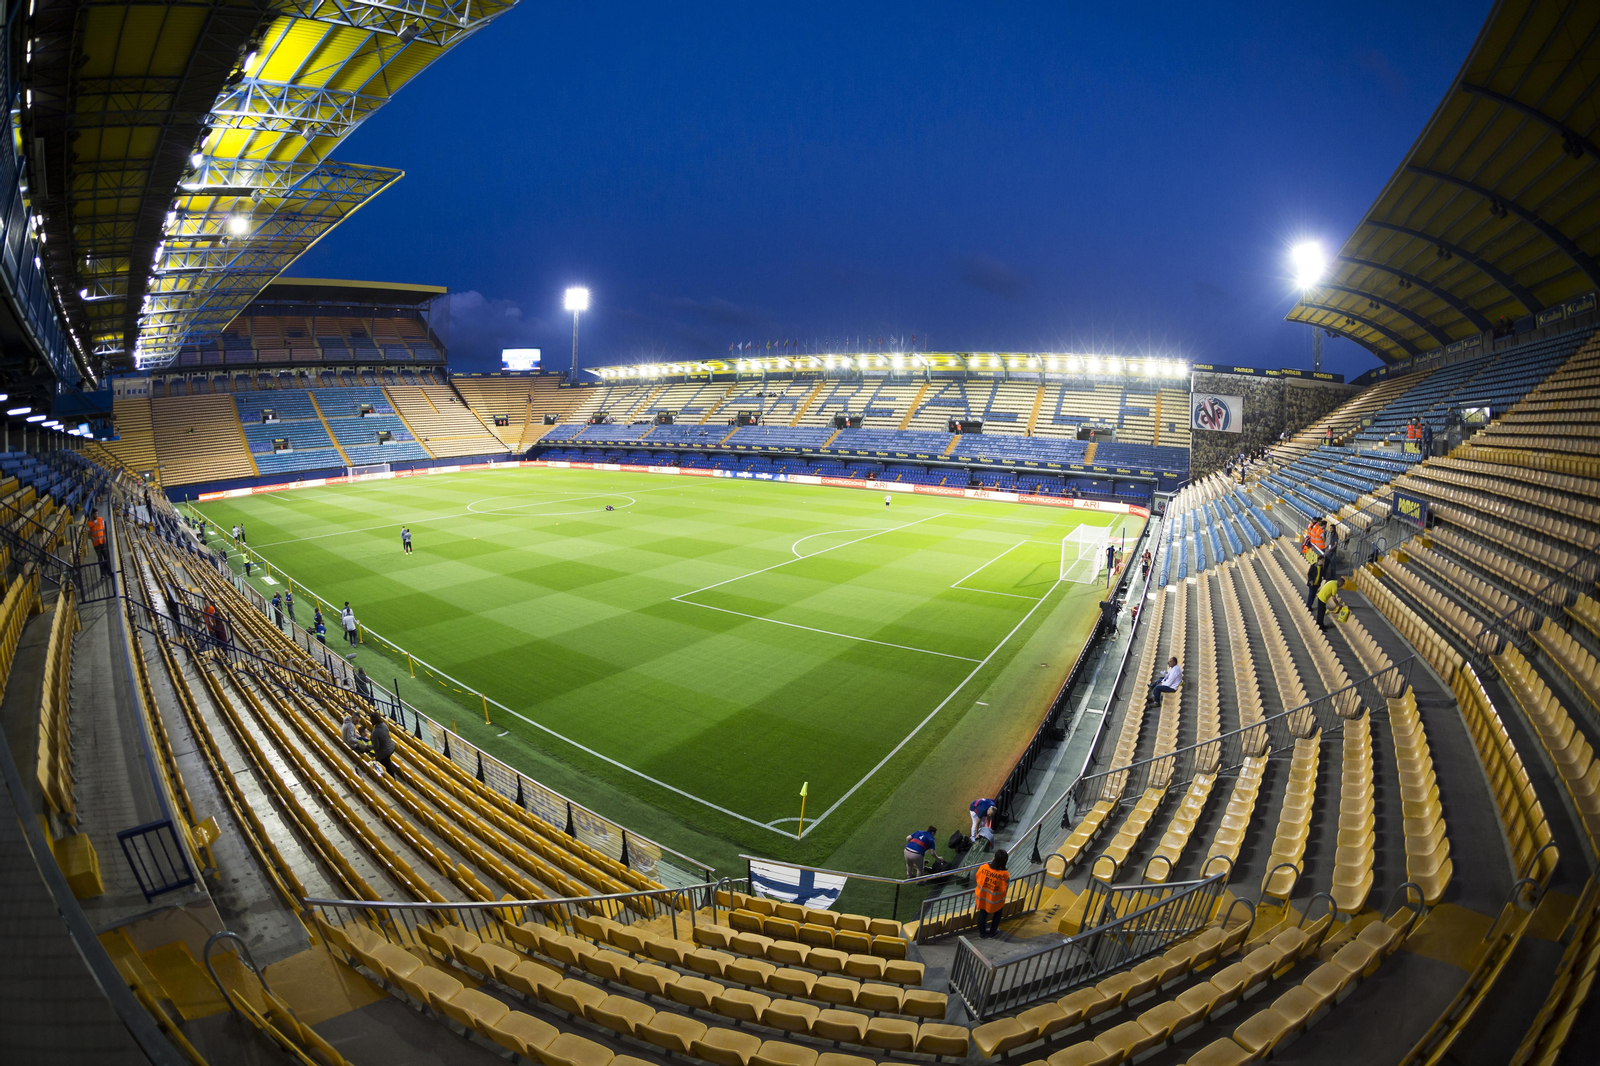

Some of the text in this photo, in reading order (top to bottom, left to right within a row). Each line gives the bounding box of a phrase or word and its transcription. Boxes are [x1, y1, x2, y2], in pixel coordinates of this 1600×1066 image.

[822, 479, 866, 487] CONSTRUCCIONES
[914, 486, 965, 496] CONSTRUCCIONES
[973, 489, 990, 498] ARI
[1019, 496, 1073, 506] CONSTRUCCIONES
[1083, 501, 1100, 509] ARI
